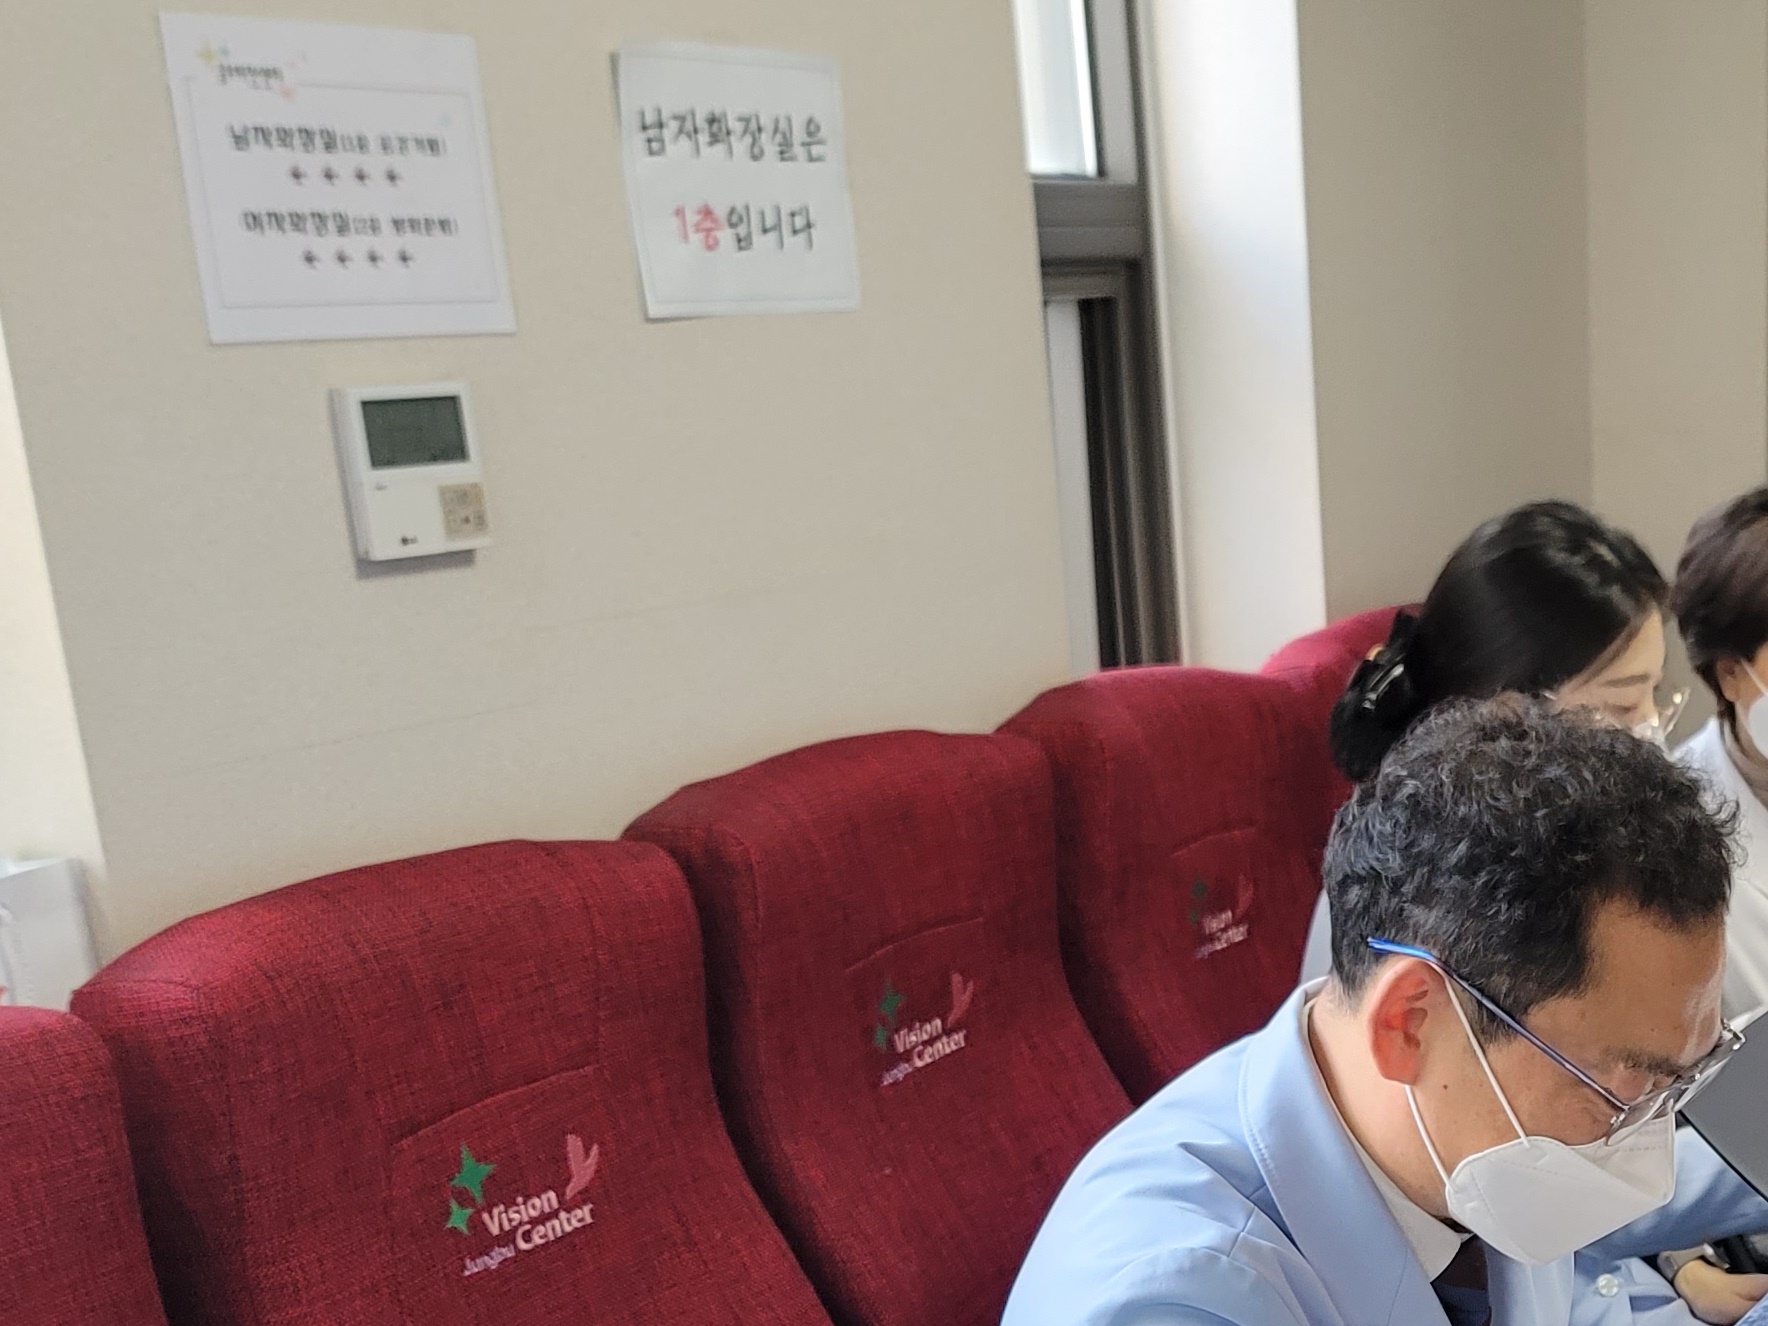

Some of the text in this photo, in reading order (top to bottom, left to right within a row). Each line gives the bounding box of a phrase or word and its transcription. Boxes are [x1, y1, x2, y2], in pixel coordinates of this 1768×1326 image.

[640, 107, 827, 163] 남자화장실은
[674, 203, 815, 252] 1층입니다
[894, 1017, 942, 1053] Vision
[913, 1030, 966, 1067] Center
[482, 1189, 559, 1236] Vision
[516, 1203, 594, 1250] Center
